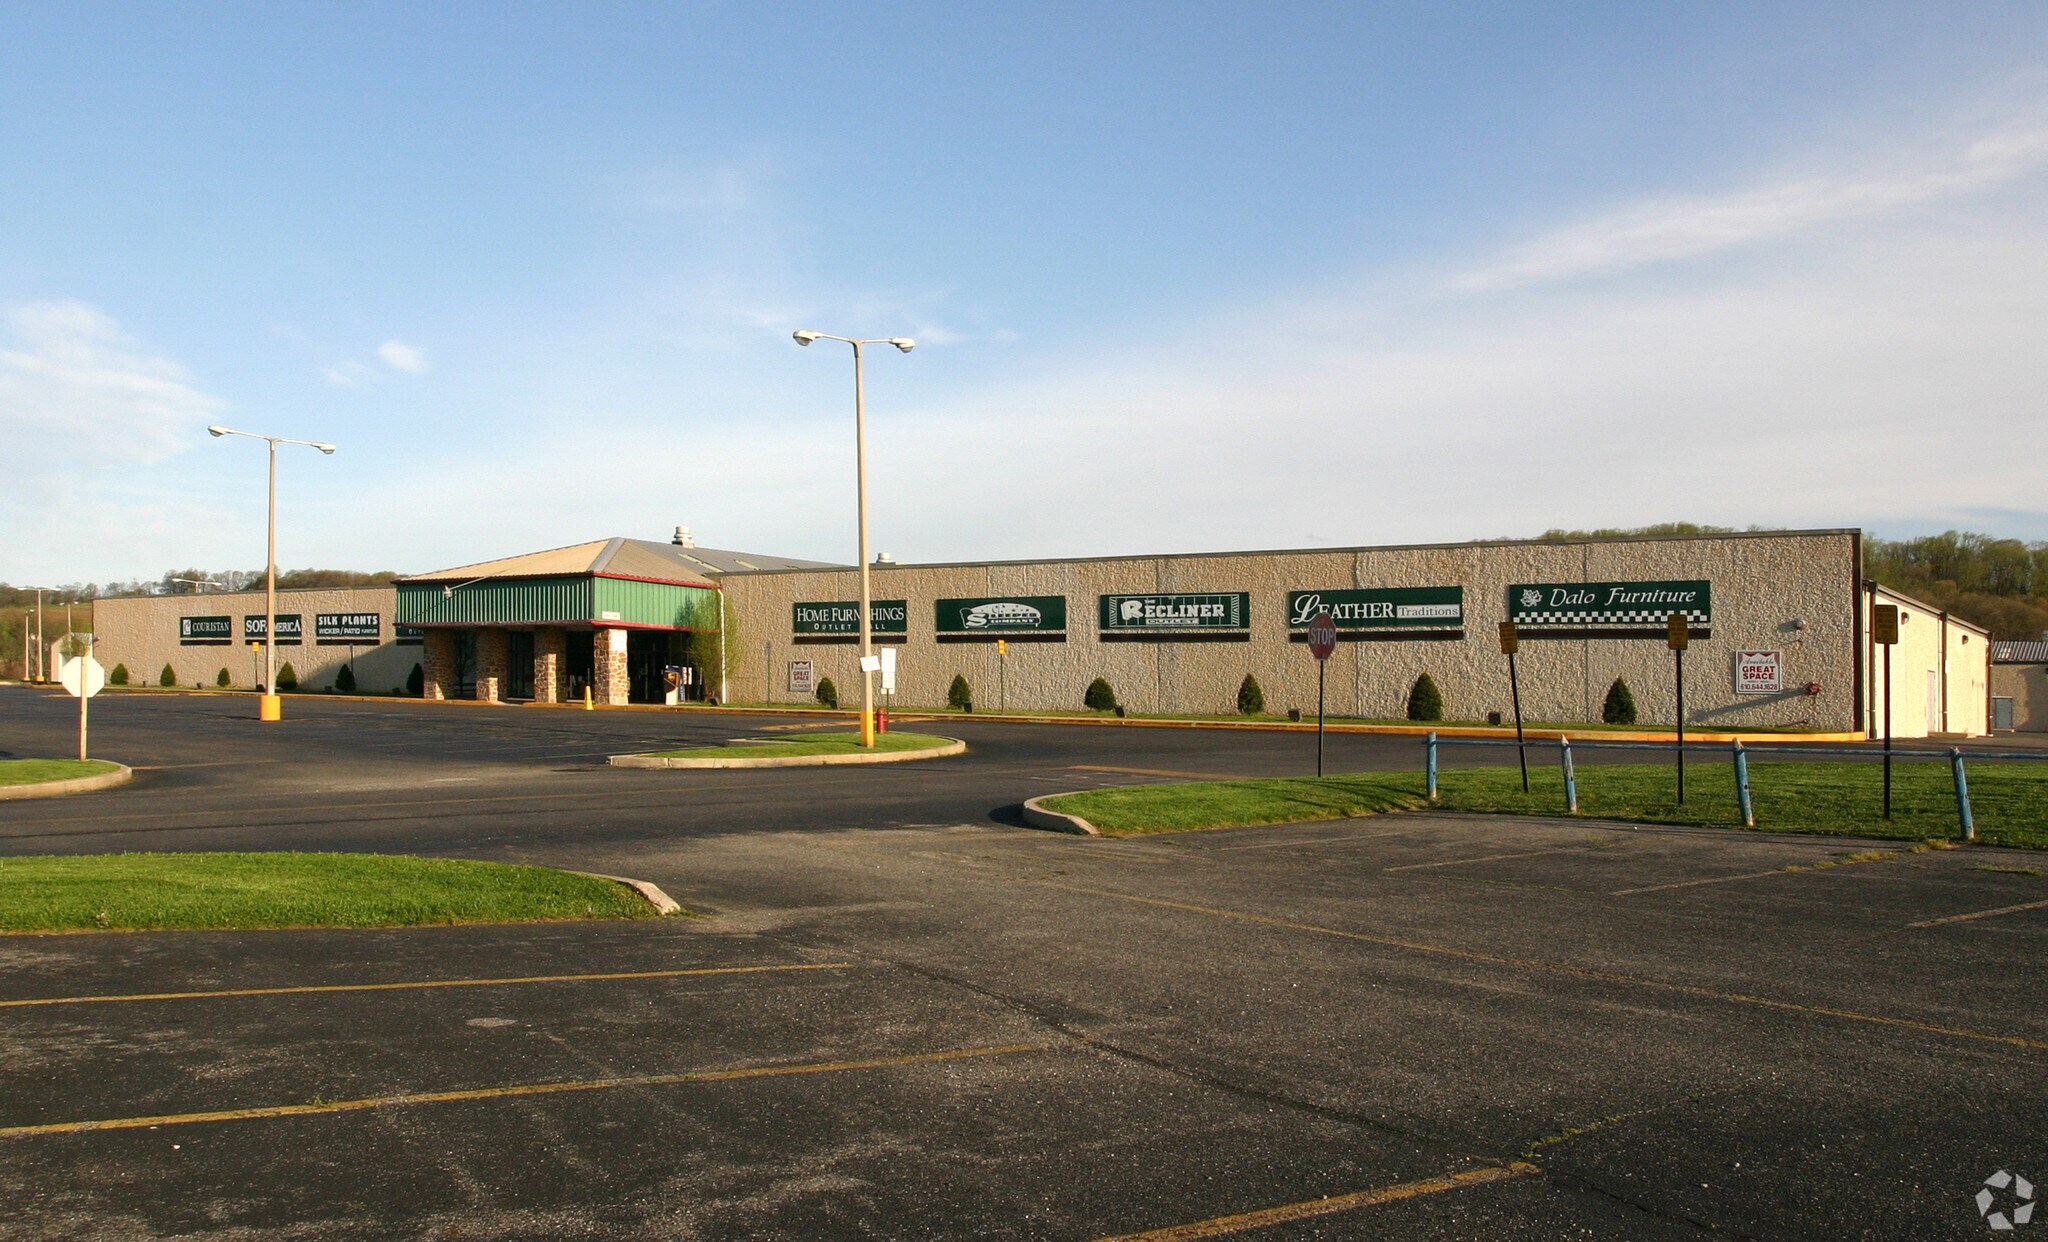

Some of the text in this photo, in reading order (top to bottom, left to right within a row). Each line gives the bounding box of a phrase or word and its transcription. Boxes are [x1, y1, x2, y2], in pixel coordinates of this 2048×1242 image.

[1550, 587, 1696, 607] Dalo Furniture
[797, 607, 905, 622] HOME FURNHINGS
[1121, 600, 1225, 620] RECLINER
[1291, 594, 1459, 624] LEATHER Traditions
[192, 621, 230, 632] COURISTAN
[318, 615, 378, 626] SILK PLANTS
[1310, 628, 1335, 645] STOP
